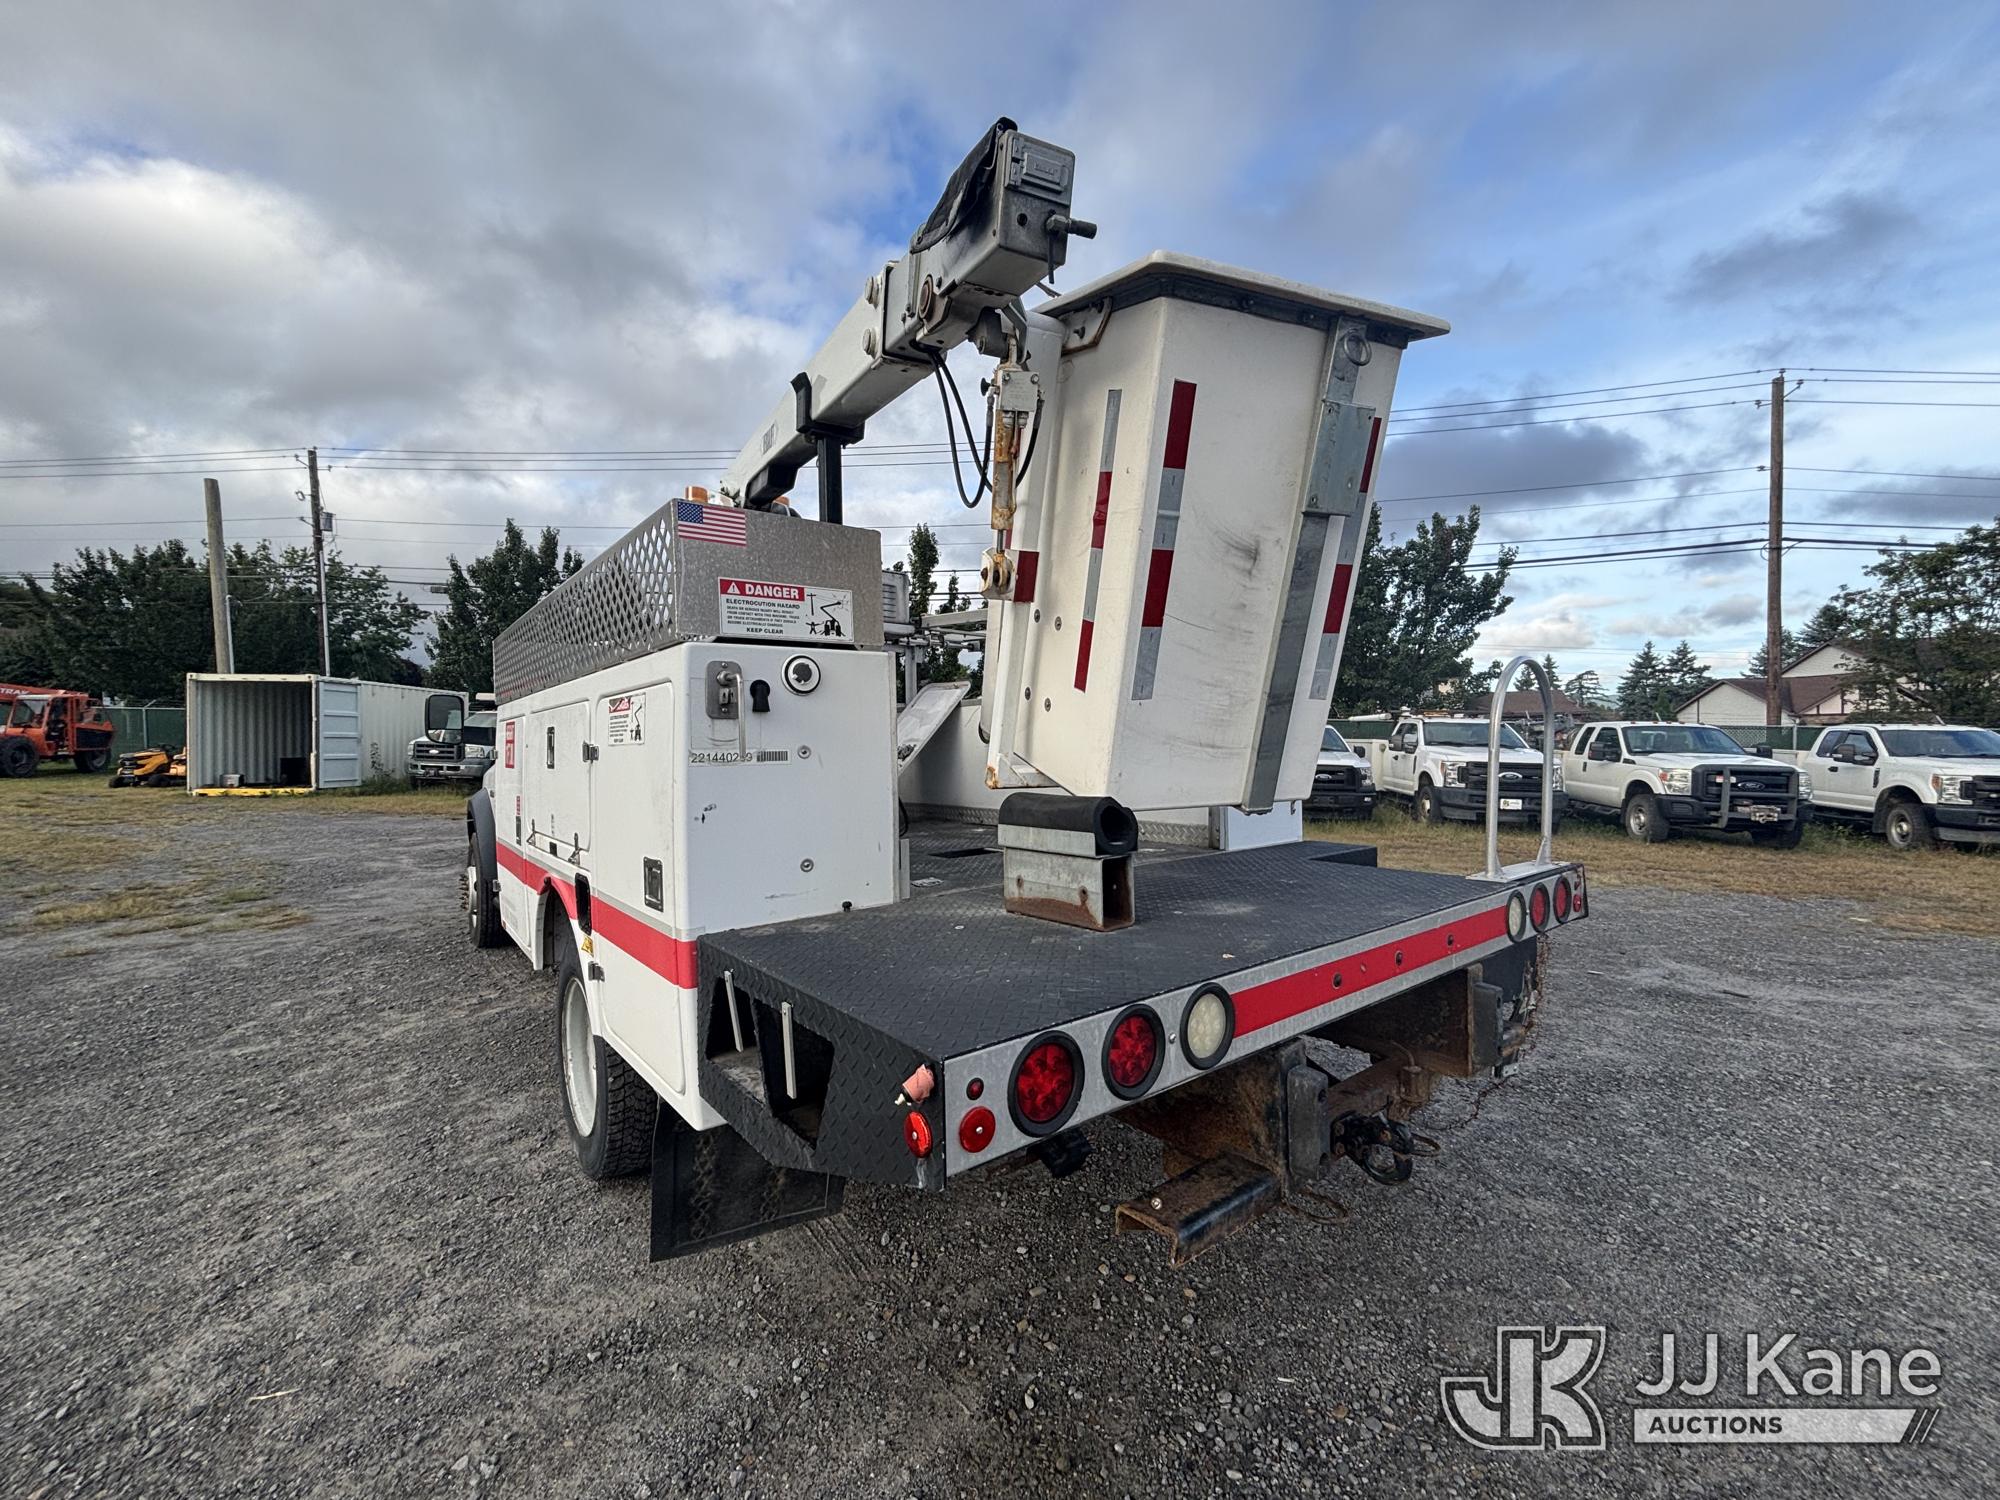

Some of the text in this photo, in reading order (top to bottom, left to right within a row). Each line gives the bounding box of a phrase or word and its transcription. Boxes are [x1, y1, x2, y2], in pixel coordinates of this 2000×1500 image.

[745, 583, 799, 599] DANGER
[726, 598, 776, 607] ELECTROCUTION
[691, 752, 753, 763] 22144029
